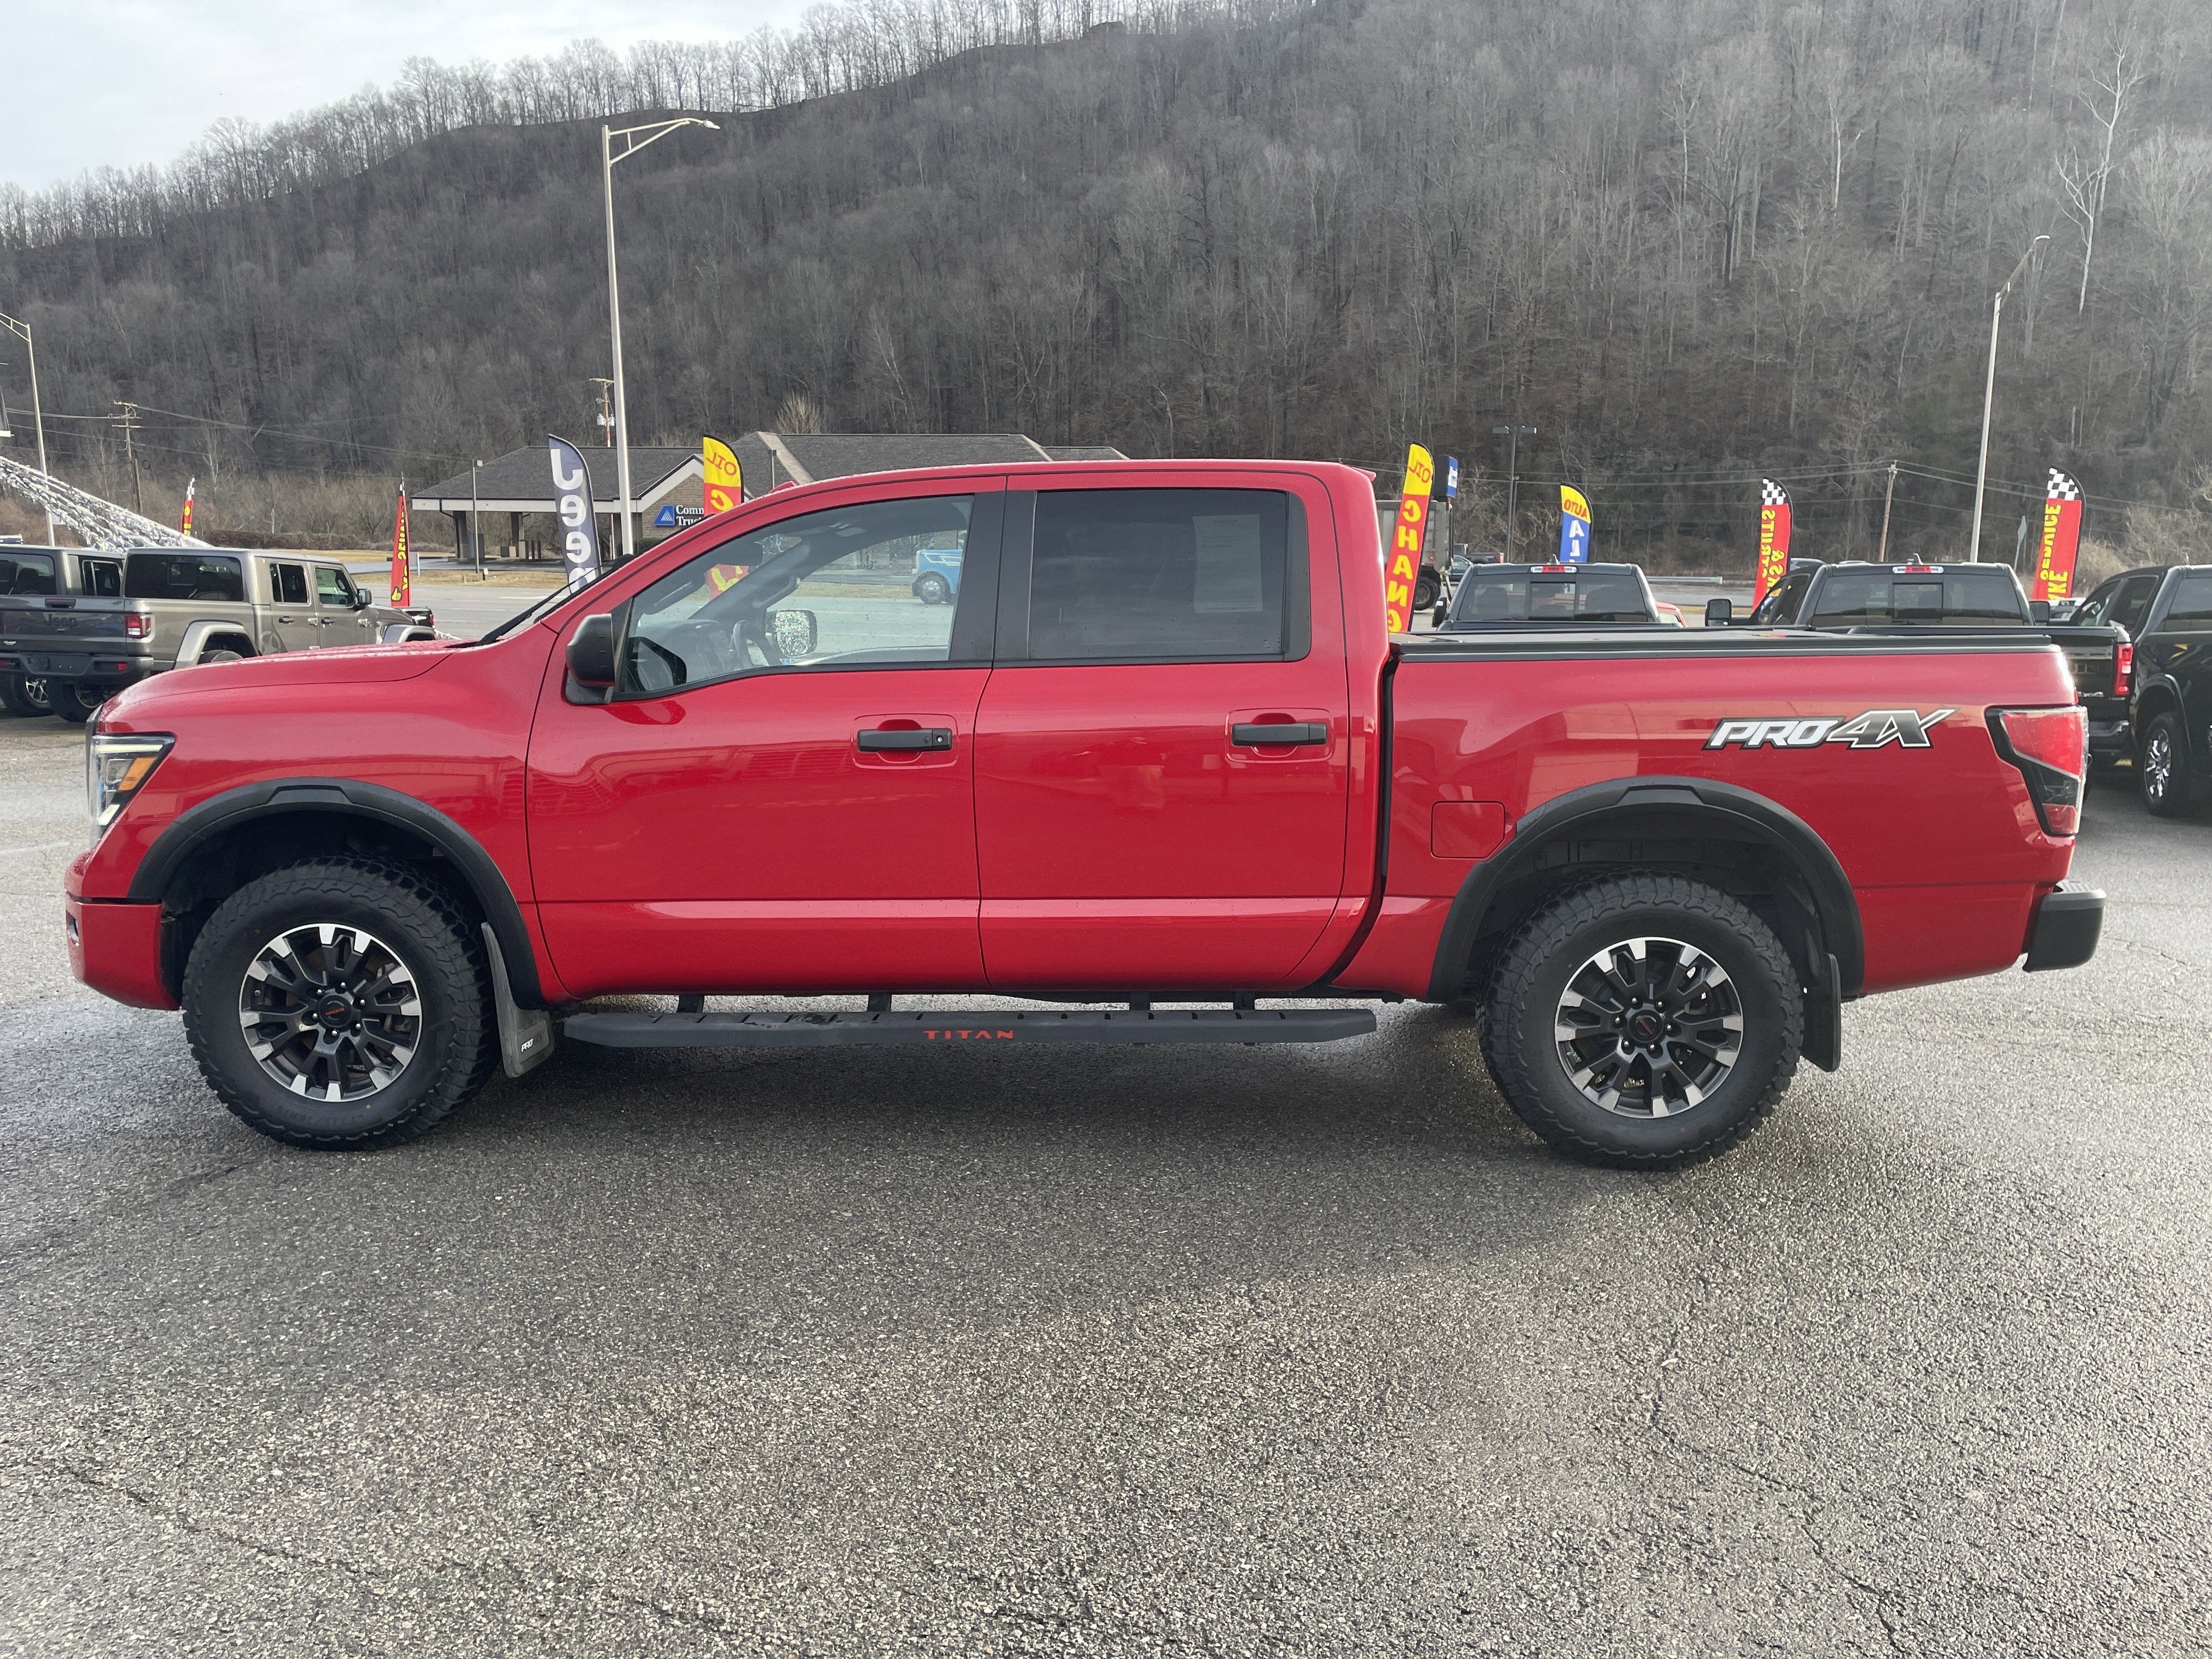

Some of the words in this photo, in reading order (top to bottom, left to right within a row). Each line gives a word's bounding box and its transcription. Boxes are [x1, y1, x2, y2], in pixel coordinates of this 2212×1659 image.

[676, 516, 702, 526] Tru
[44, 613, 77, 627] Jeep
[922, 1029, 1014, 1040] TITAN
